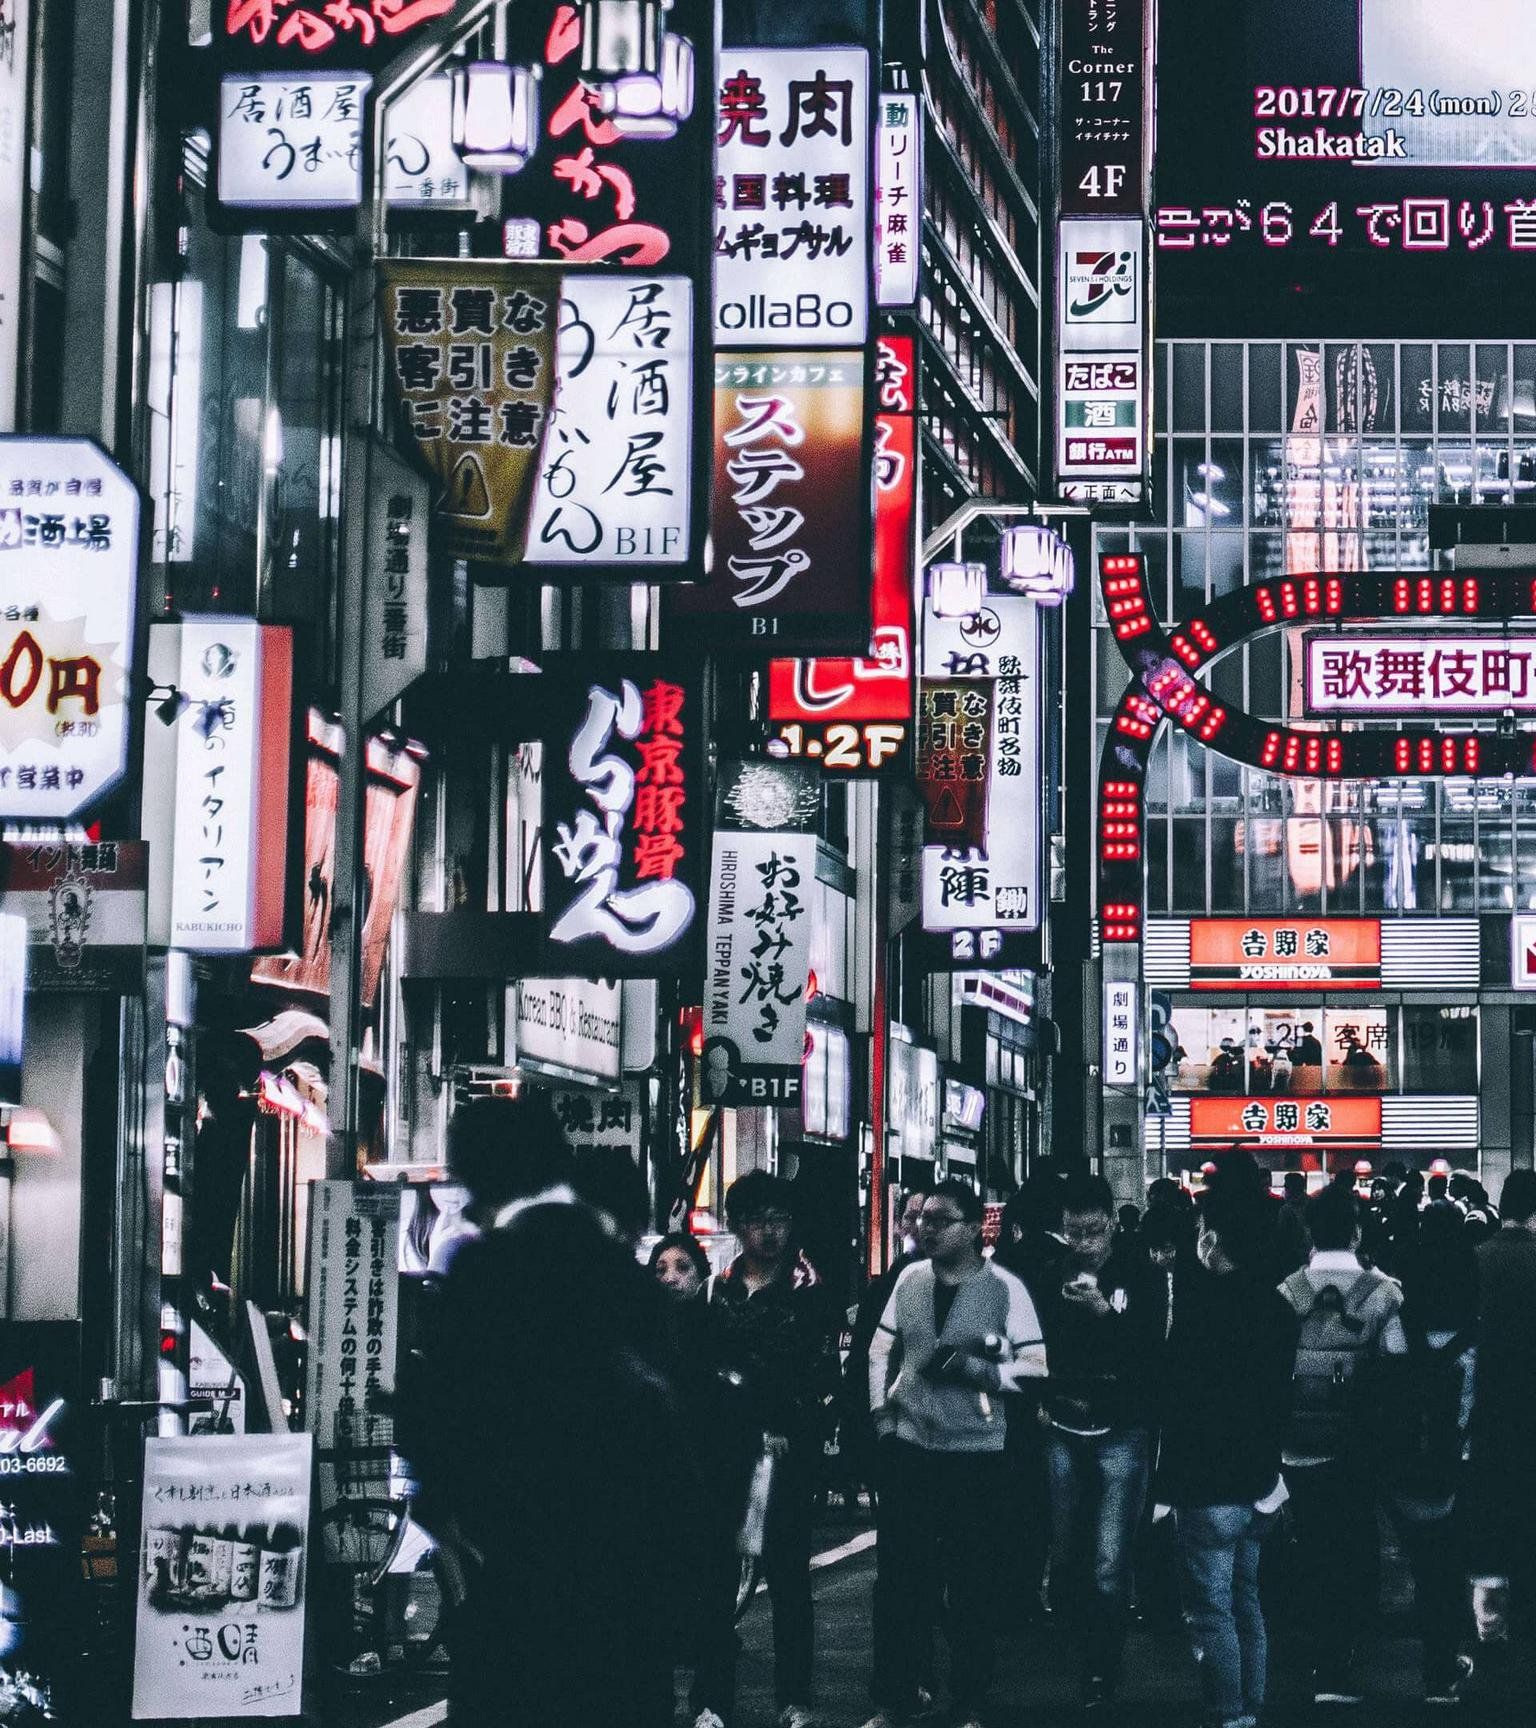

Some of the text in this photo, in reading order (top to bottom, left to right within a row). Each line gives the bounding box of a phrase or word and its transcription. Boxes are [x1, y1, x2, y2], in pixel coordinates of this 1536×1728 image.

[1092, 45, 1114, 54] The
[1068, 60, 1134, 74] Corner
[227, 84, 359, 123] 居酒屋
[1081, 81, 1122, 102] 117
[1075, 118, 1131, 126] ザ・コーナー
[1075, 132, 1130, 141] イチイチナナ
[1256, 129, 1406, 159] Shakatak
[1079, 165, 1126, 197] 4F
[396, 289, 548, 334] 悪質な
[716, 294, 852, 330] ollaBo
[397, 346, 545, 391] 客引き
[1067, 364, 1136, 390] たばこ
[601, 285, 673, 497] 居酒屋
[411, 401, 544, 447] に注意
[1084, 402, 1117, 427] 酒
[1069, 442, 1134, 461] 銀行ATM
[725, 396, 811, 607] ステップ
[1084, 485, 1135, 499] 正面へ
[614, 526, 681, 555] B1F
[752, 617, 780, 635] B1
[176, 922, 243, 932] KABUKICHO
[712, 850, 738, 1024] HIROSHIMA TEPPANYAKI
[740, 851, 804, 1043] お好み焼き
[953, 931, 1002, 959] 2F
[1242, 929, 1330, 957] 吉野家
[1240, 965, 1331, 980] YOSHINOYA
[550, 990, 567, 1040] BBQ
[1112, 991, 1128, 1075] 劇場通り
[752, 1079, 799, 1098] B1F
[1243, 1103, 1331, 1131] 吉野家
[1259, 1134, 1313, 1144] YOSHINOYA
